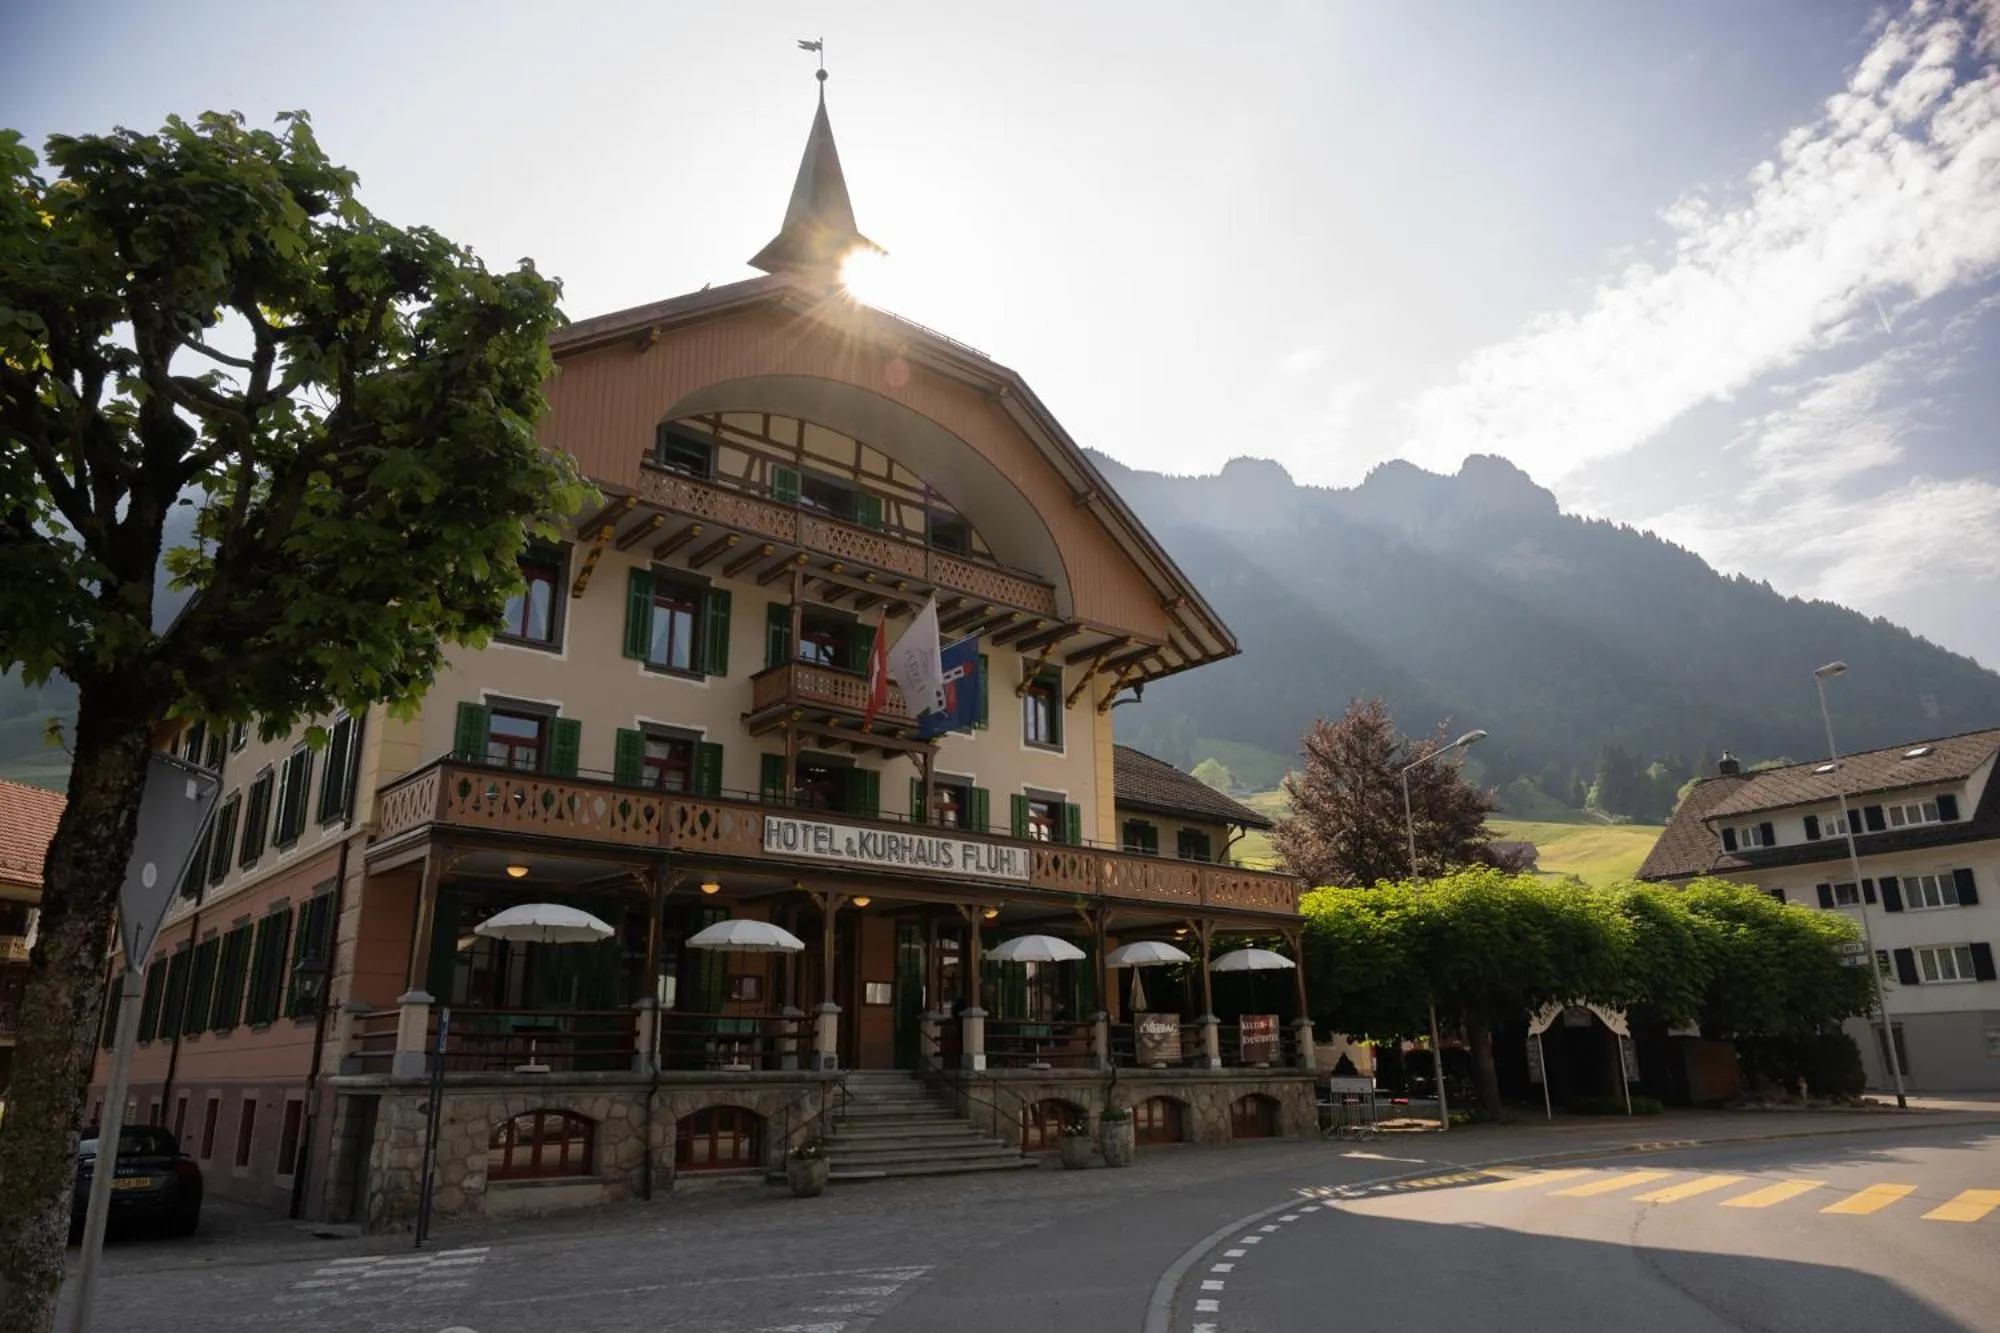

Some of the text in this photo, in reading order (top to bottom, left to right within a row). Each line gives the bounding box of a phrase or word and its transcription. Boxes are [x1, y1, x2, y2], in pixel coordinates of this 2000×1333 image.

[766, 819, 842, 856] HOTEL
[845, 836, 857, 858] &
[859, 831, 954, 868] KURHAUS
